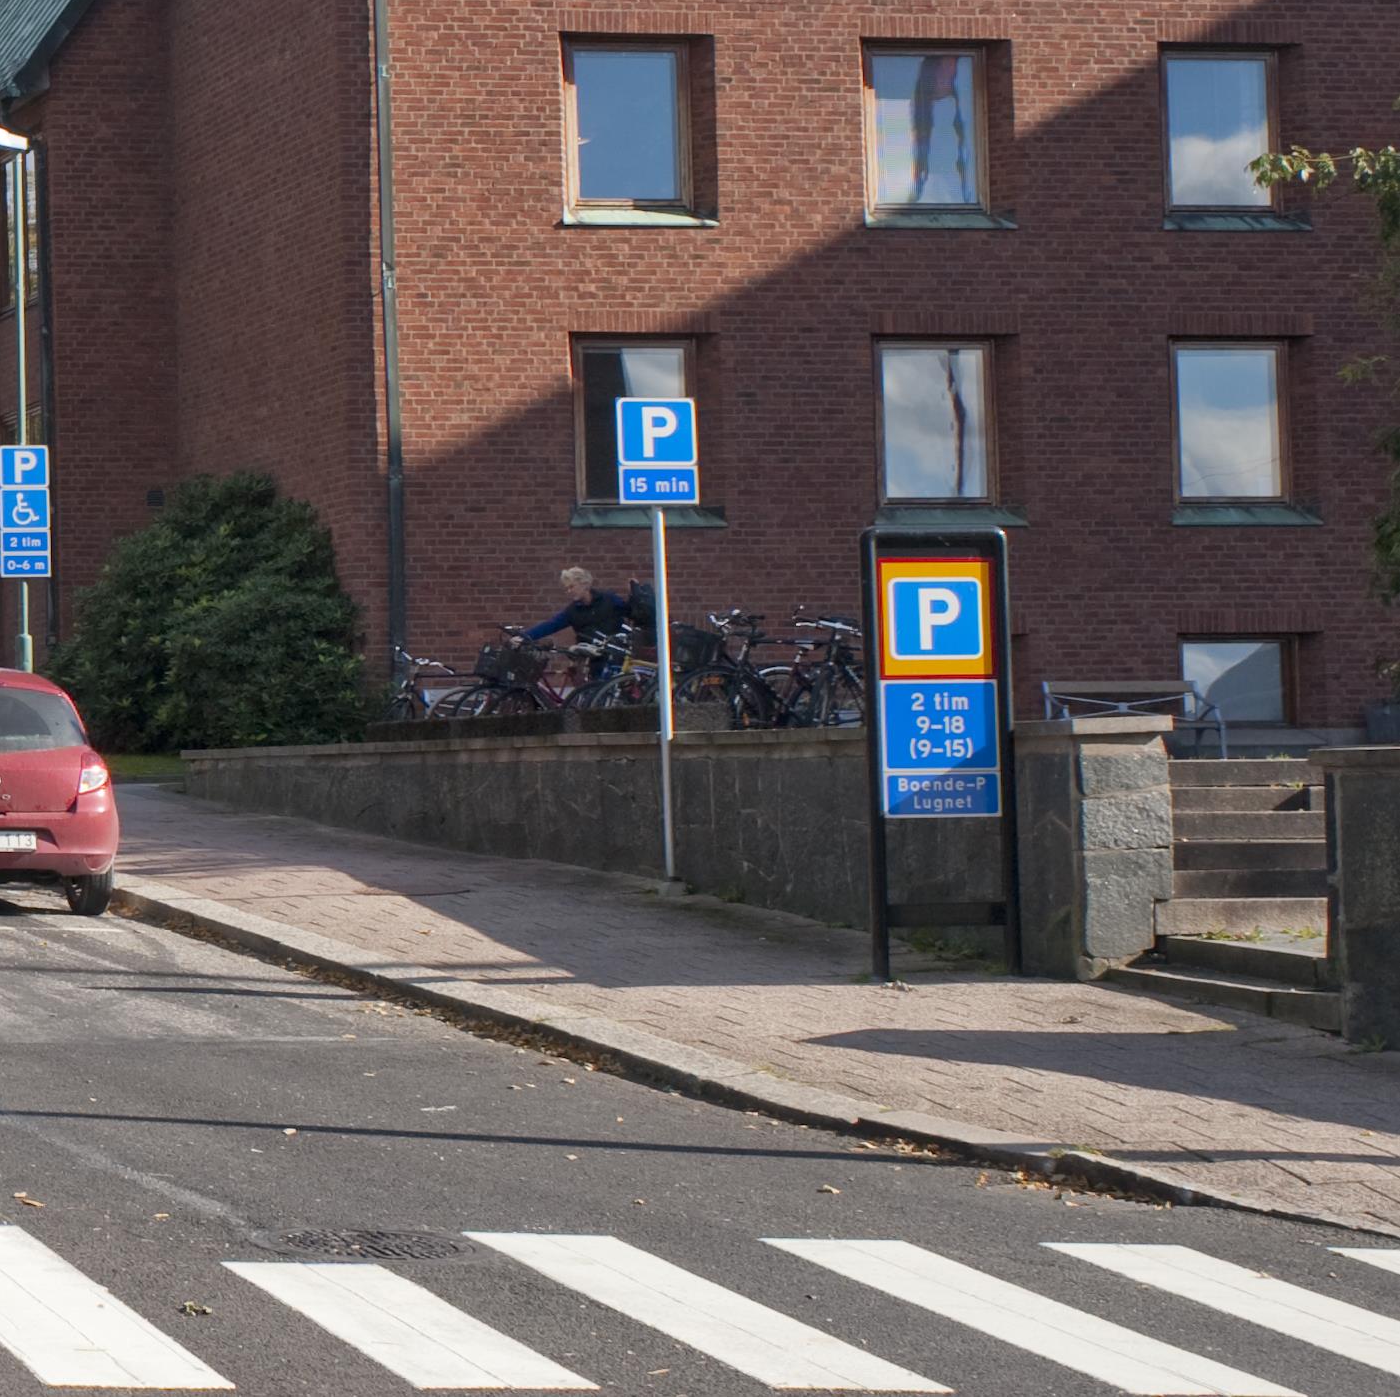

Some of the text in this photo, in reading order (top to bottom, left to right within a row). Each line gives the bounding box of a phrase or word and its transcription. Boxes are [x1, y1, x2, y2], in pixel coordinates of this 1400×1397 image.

[641, 406, 678, 458] P
[13, 450, 38, 484] P
[629, 477, 690, 493] 15 min
[9, 537, 42, 548] 2 tim
[7, 560, 46, 571] 0-6 m
[917, 587, 962, 651] P
[910, 691, 969, 711] 2 tim
[916, 715, 966, 734] 9-18
[909, 737, 974, 759] (9-15)
[897, 776, 986, 792] Boende-P
[913, 795, 972, 812] Lugnet
